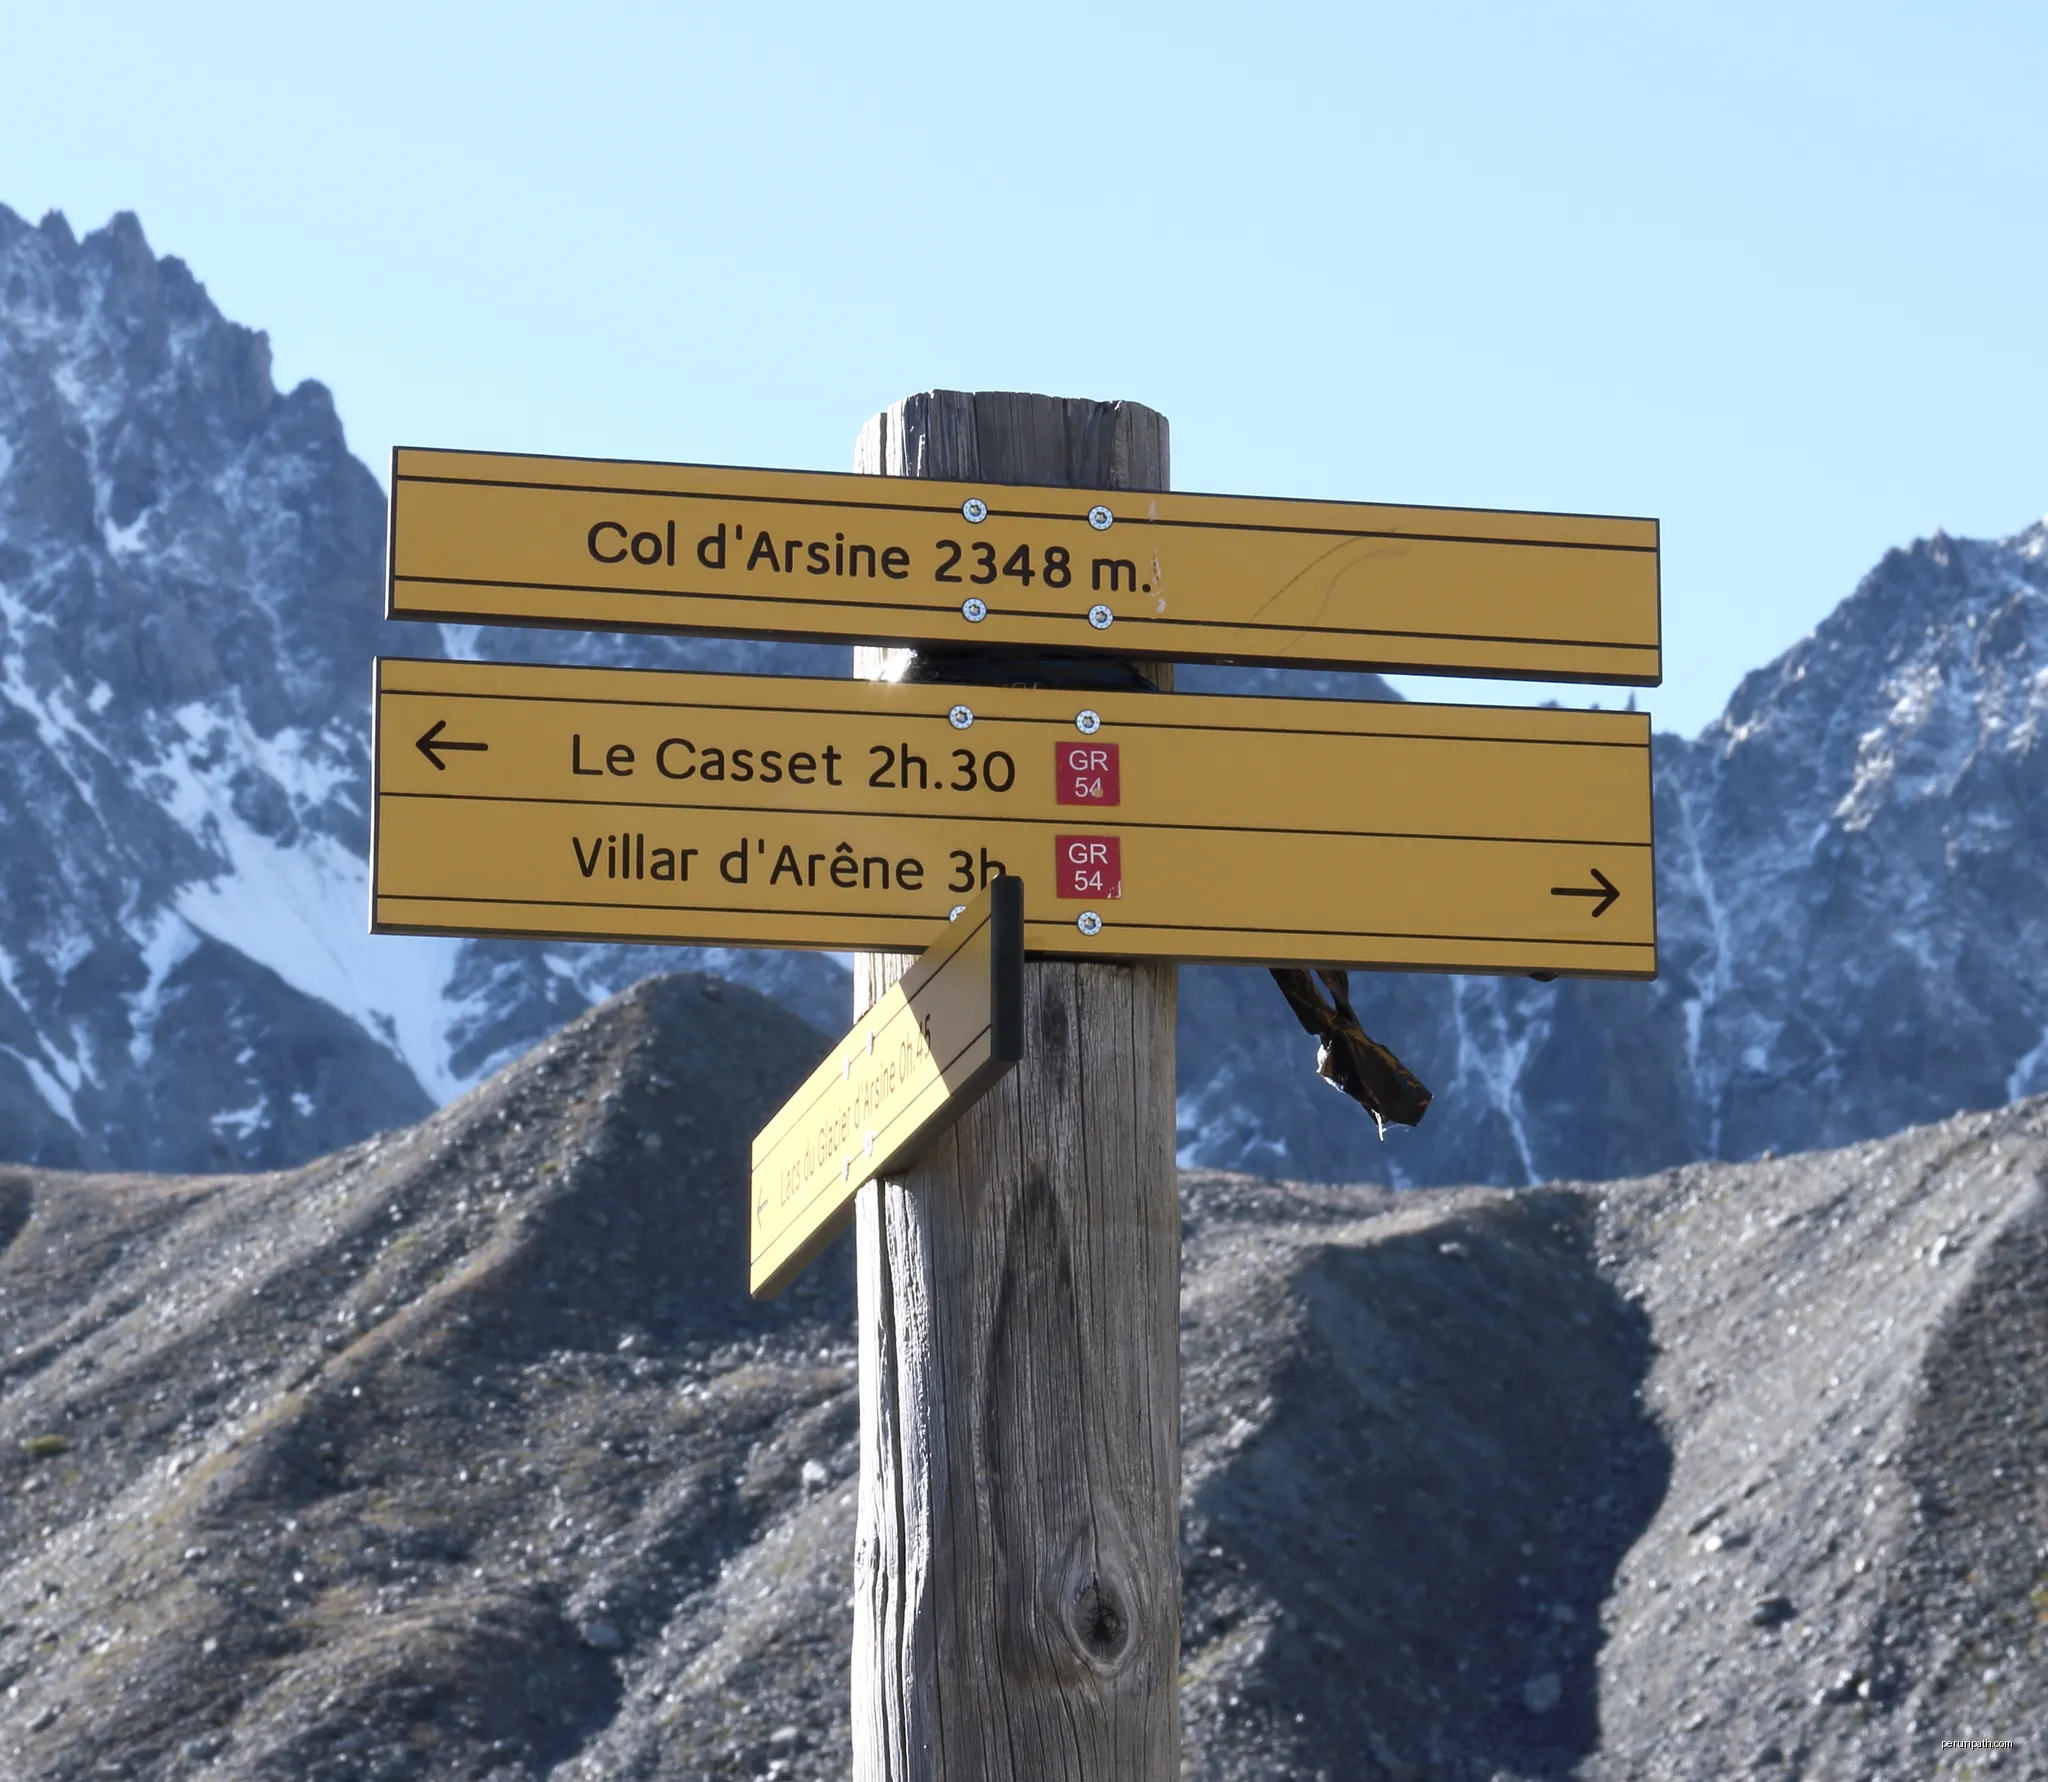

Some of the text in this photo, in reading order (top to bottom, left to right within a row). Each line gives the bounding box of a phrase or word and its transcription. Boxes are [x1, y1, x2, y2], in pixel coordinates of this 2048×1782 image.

[588, 520, 1152, 593] Col d'Arsine 2348 m.
[573, 734, 1015, 793] Le Casset 2h.30
[1069, 750, 1108, 771] GR
[572, 833, 1007, 894] Villar d'Arêne 3h
[1068, 843, 1108, 864] GR
[1074, 870, 1104, 891] 54
[780, 1159, 801, 1207] Lacs
[803, 1137, 815, 1182] du
[817, 1104, 851, 1167] Glacier
[853, 1061, 896, 1129] d'Arsine
